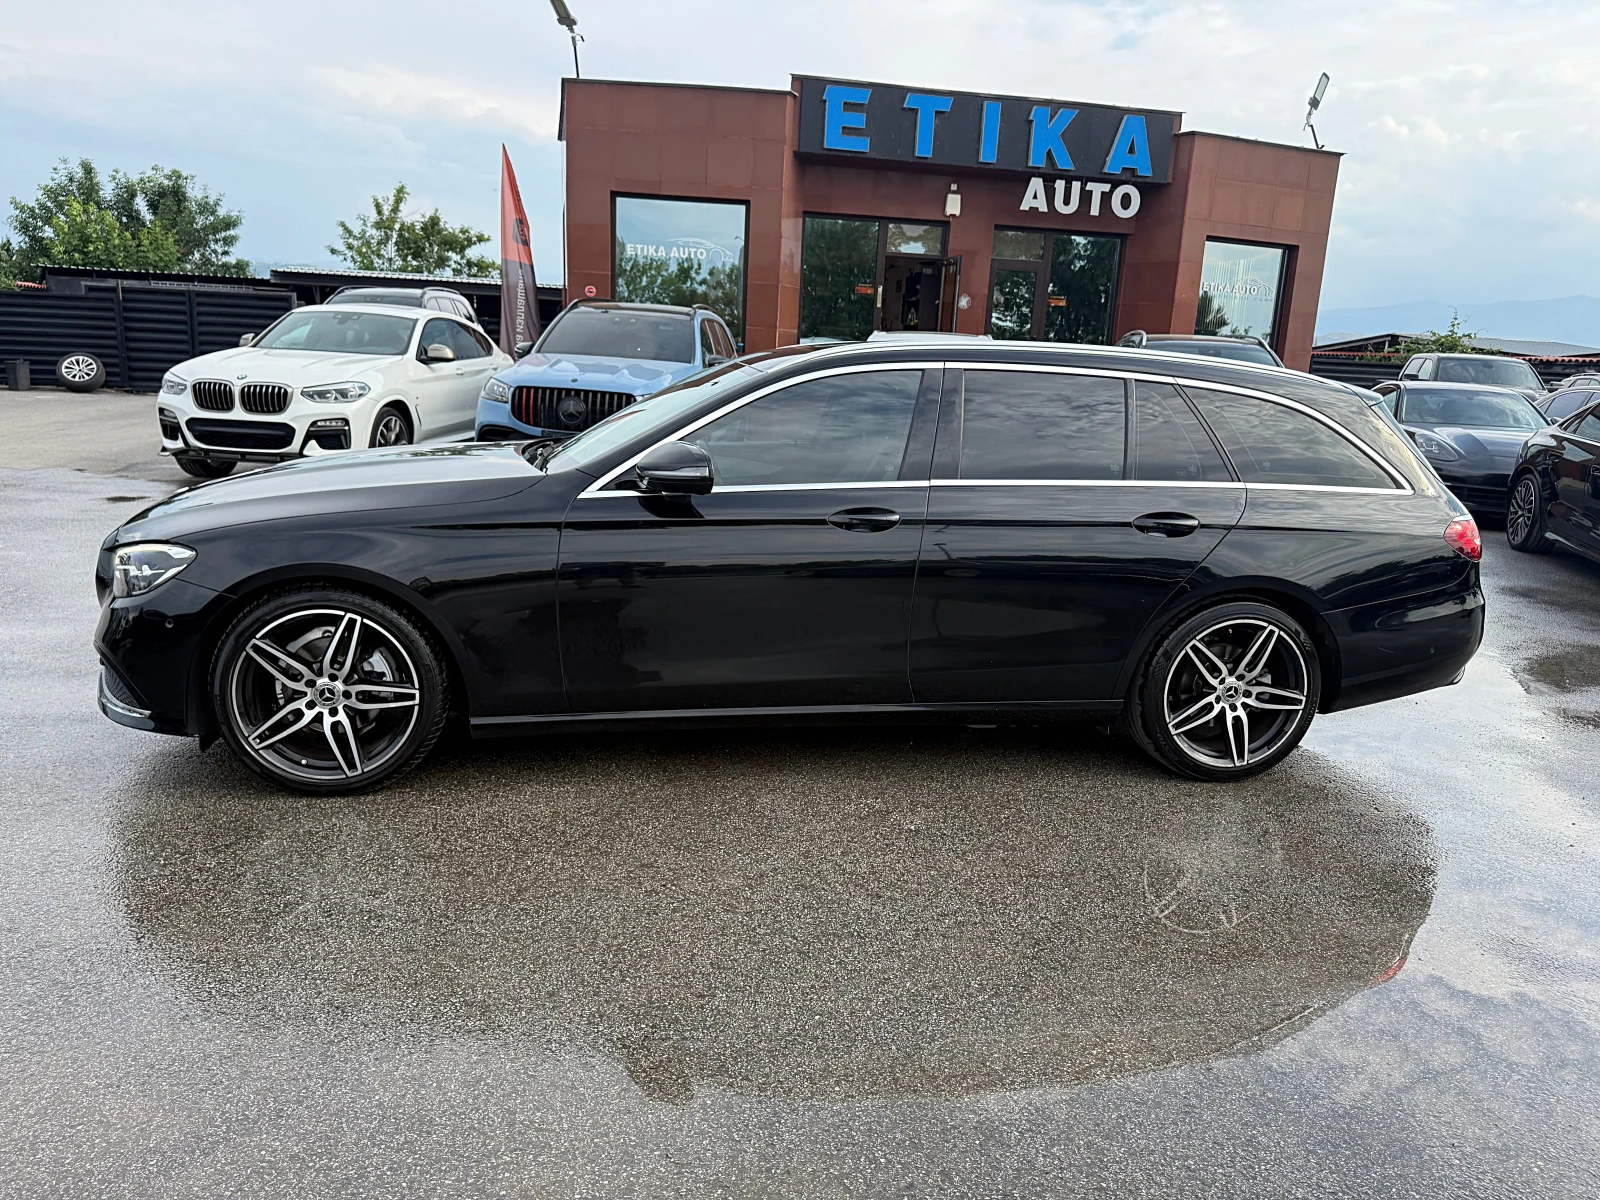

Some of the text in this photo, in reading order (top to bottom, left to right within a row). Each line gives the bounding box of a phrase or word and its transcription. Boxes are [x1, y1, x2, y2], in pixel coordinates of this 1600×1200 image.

[823, 84, 1153, 177] ETIKA
[1019, 177, 1142, 219] AUTO
[626, 243, 707, 260] ETIKA AUTO
[1203, 282, 1258, 295] ETIKA AUTO
